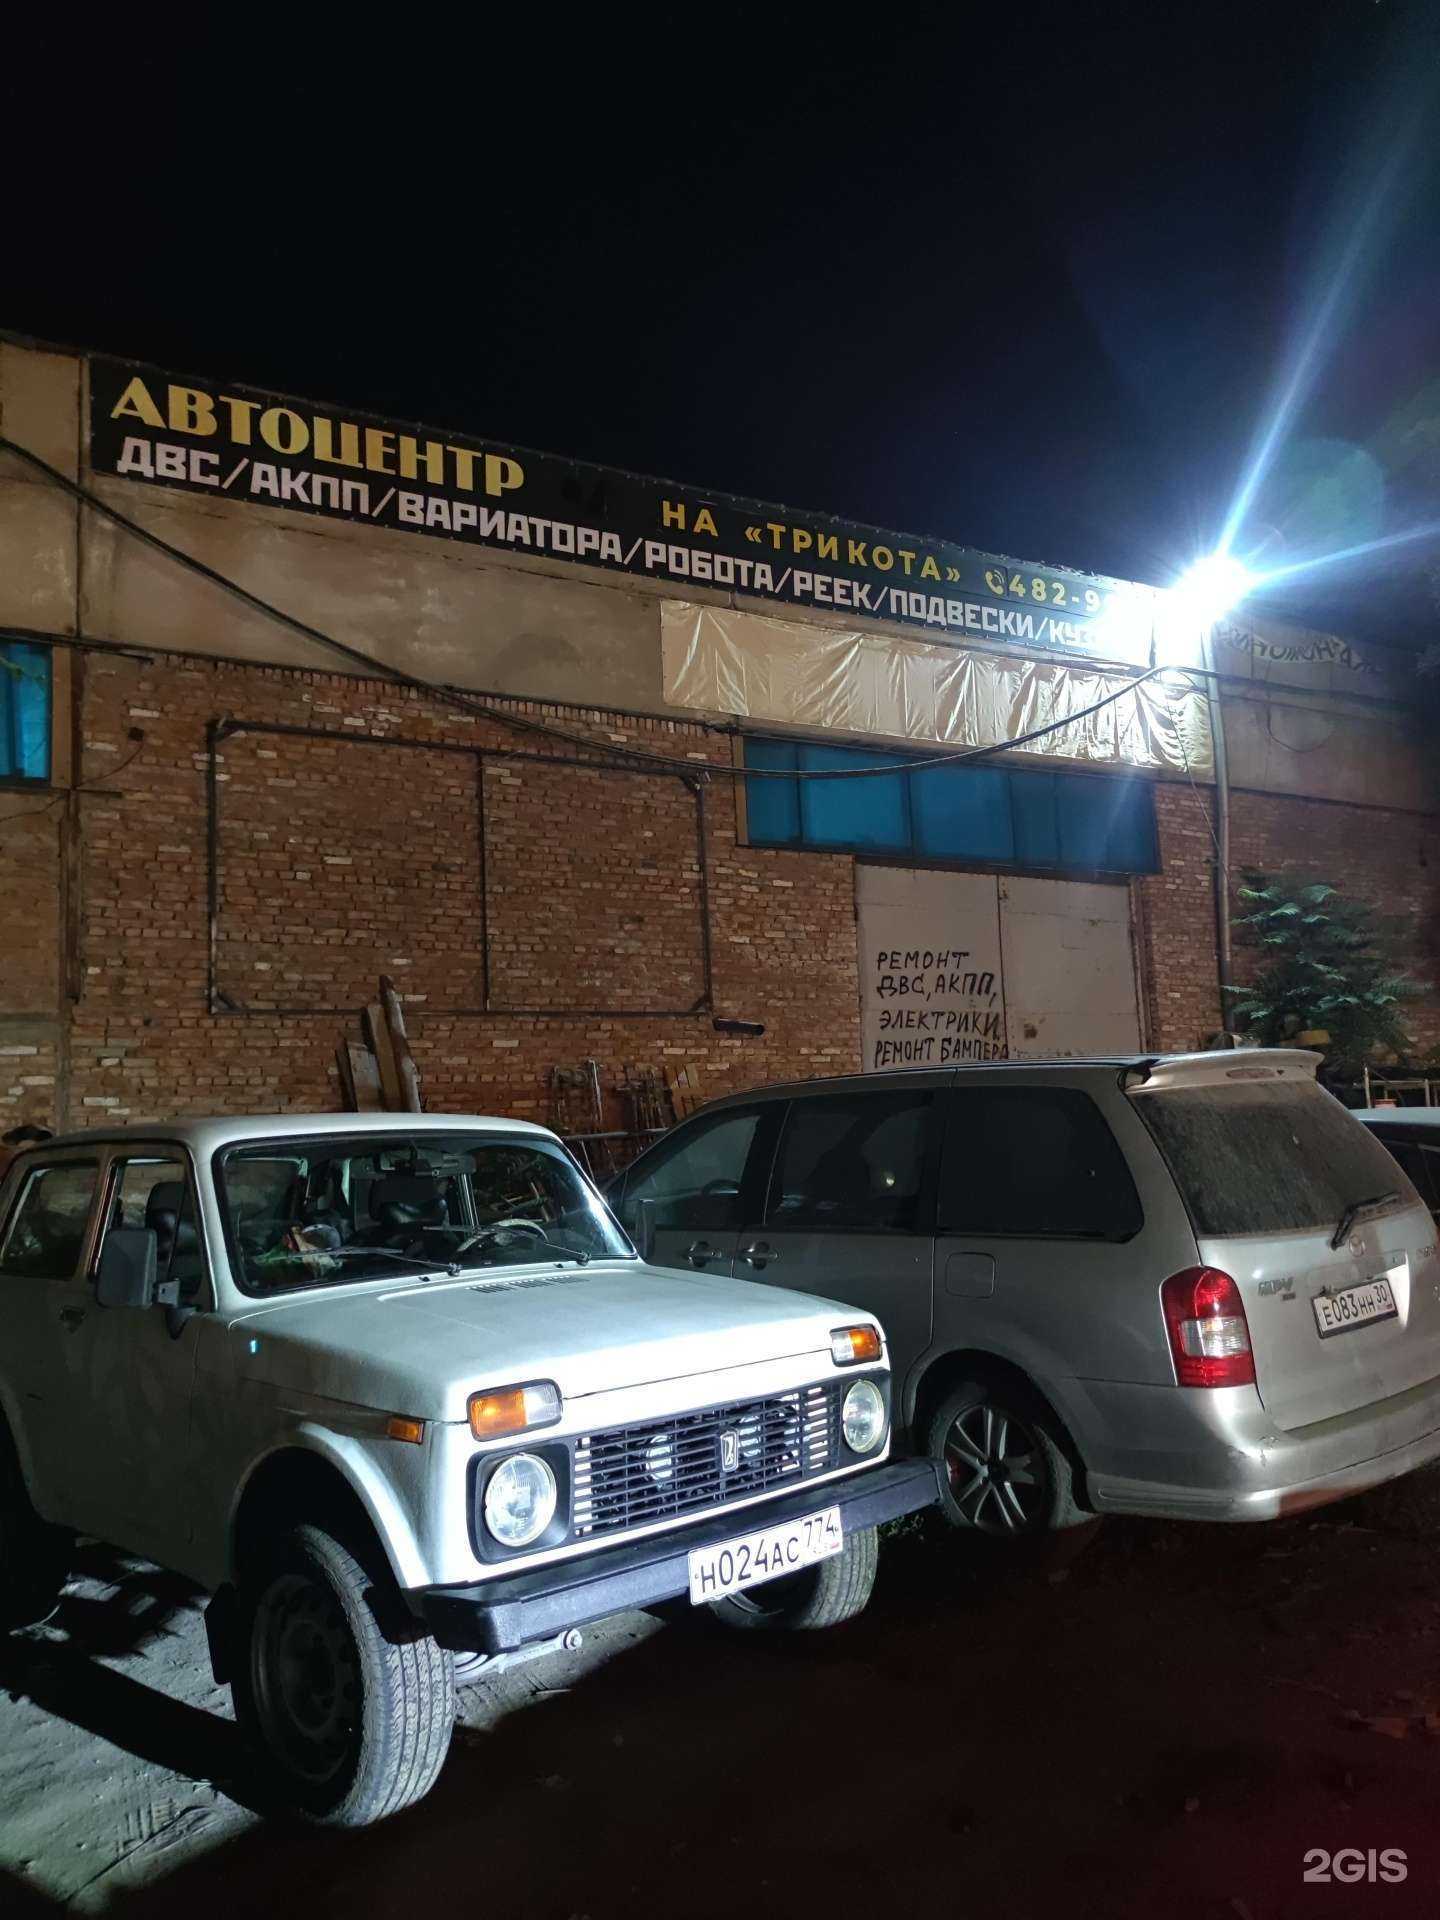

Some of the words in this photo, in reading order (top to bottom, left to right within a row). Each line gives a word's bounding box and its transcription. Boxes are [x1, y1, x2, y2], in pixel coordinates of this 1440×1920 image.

[110, 376, 525, 497] АВТОЦЕНТР
[662, 500, 719, 537] НА
[1009, 574, 1110, 614] 482-9
[877, 950, 970, 971] РЕМОНТ
[874, 1038, 935, 1068] РЕМОНТ
